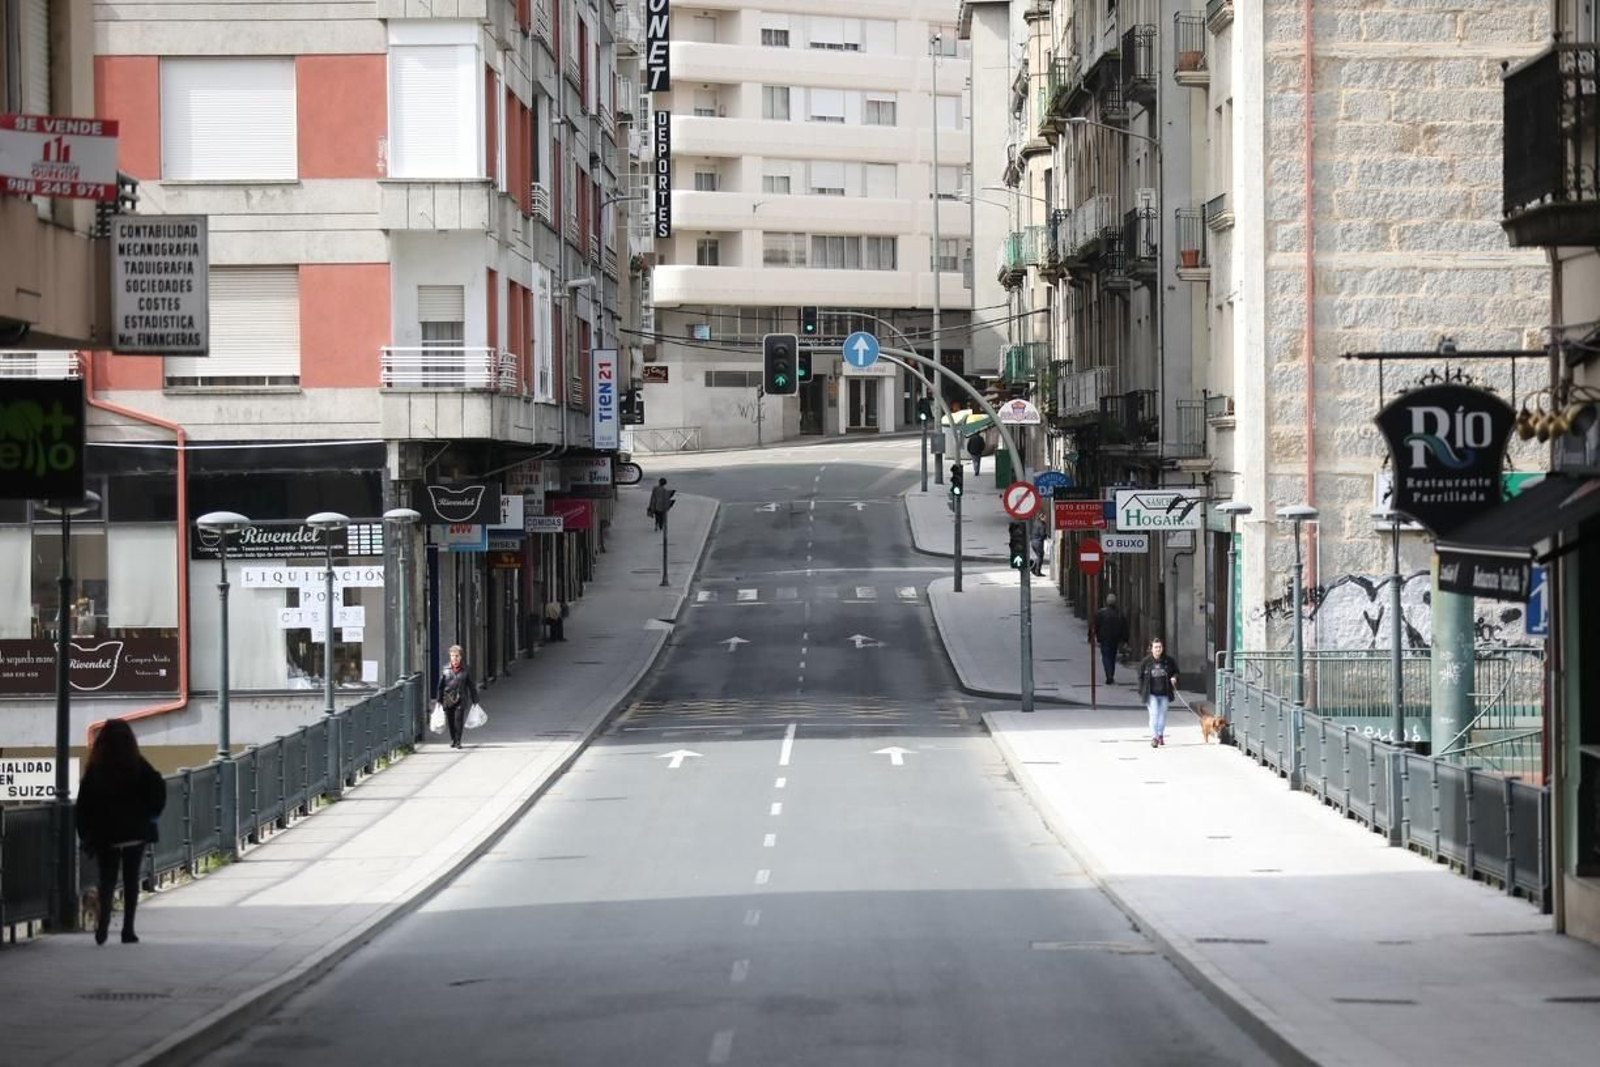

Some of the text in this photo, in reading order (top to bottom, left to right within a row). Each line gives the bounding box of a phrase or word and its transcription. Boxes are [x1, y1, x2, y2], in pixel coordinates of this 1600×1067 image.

[14, 117, 103, 135] SE VENDE
[658, 112, 668, 238] DEPORTES
[7, 178, 105, 198] 988 245 971
[121, 225, 198, 238] CONTABILIDAD
[118, 243, 199, 256] MECANOGRAFIA
[124, 261, 194, 275] TAQUIGRAFIA
[125, 279, 193, 293] SOCIEDADES
[138, 298, 181, 311] COSTES
[124, 315, 194, 329] ESTADISTICA
[137, 333, 201, 346] FINANCIERAS
[1407, 477, 1491, 488] Restaurante
[438, 498, 475, 506] Rivendel
[1413, 491, 1485, 503] Parrillada
[526, 519, 561, 527] COMIDAS
[240, 526, 321, 544] Rivendel
[490, 541, 516, 549] NISEX
[1116, 540, 1144, 548] BUXO
[246, 568, 384, 583] LIQUIDACIÓN
[303, 592, 340, 601] POR
[70, 659, 112, 669] Rivendel
[0, 762, 52, 773] IALIDAD
[8, 785, 55, 797] SUIZO
